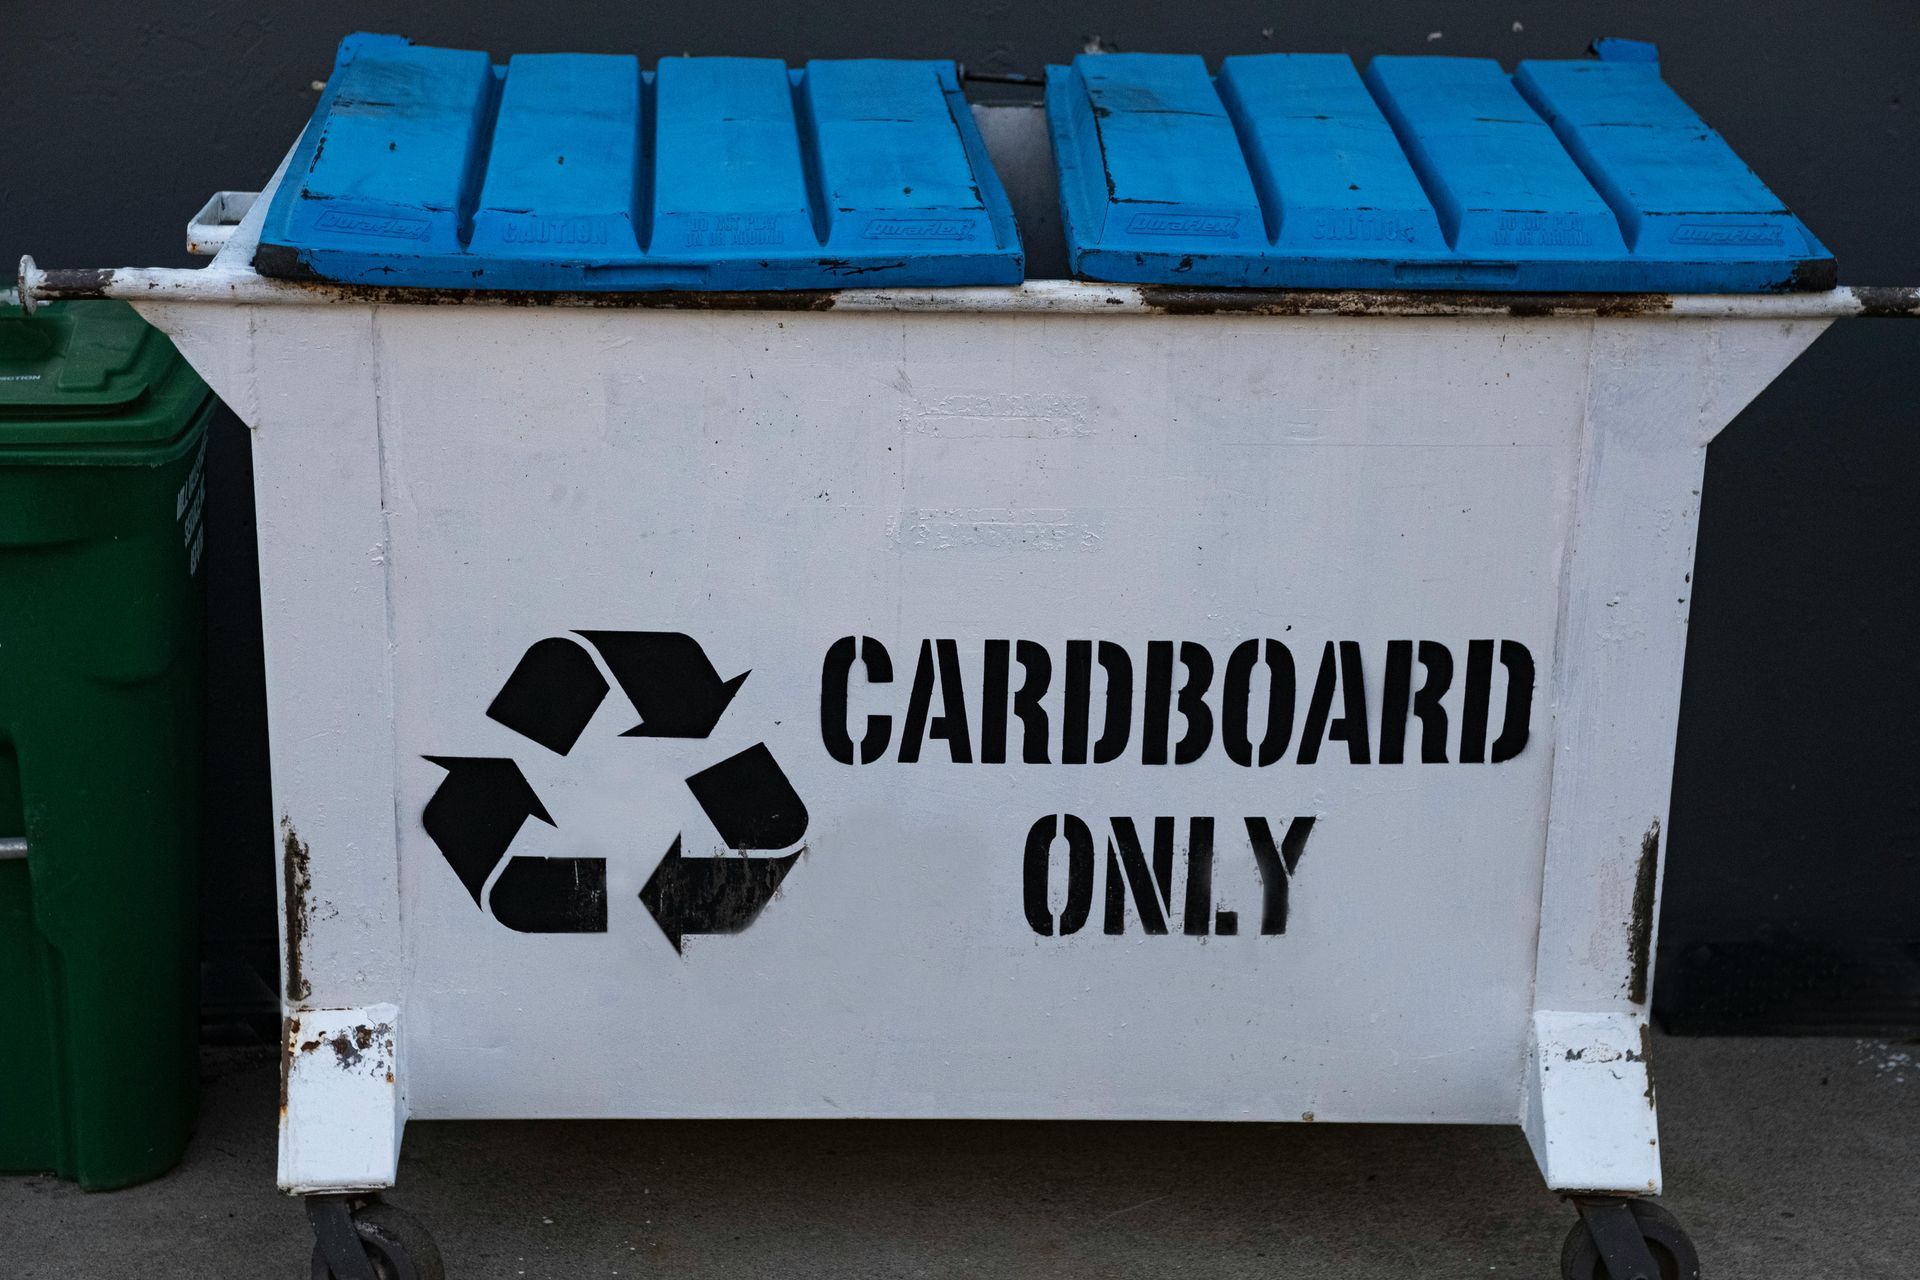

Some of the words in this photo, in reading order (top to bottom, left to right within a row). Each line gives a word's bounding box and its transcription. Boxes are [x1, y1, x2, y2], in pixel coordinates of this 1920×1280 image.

[504, 220, 608, 244] CAUTION
[821, 636, 1535, 767] CARDBOARD
[1023, 814, 1316, 936] ONLY
